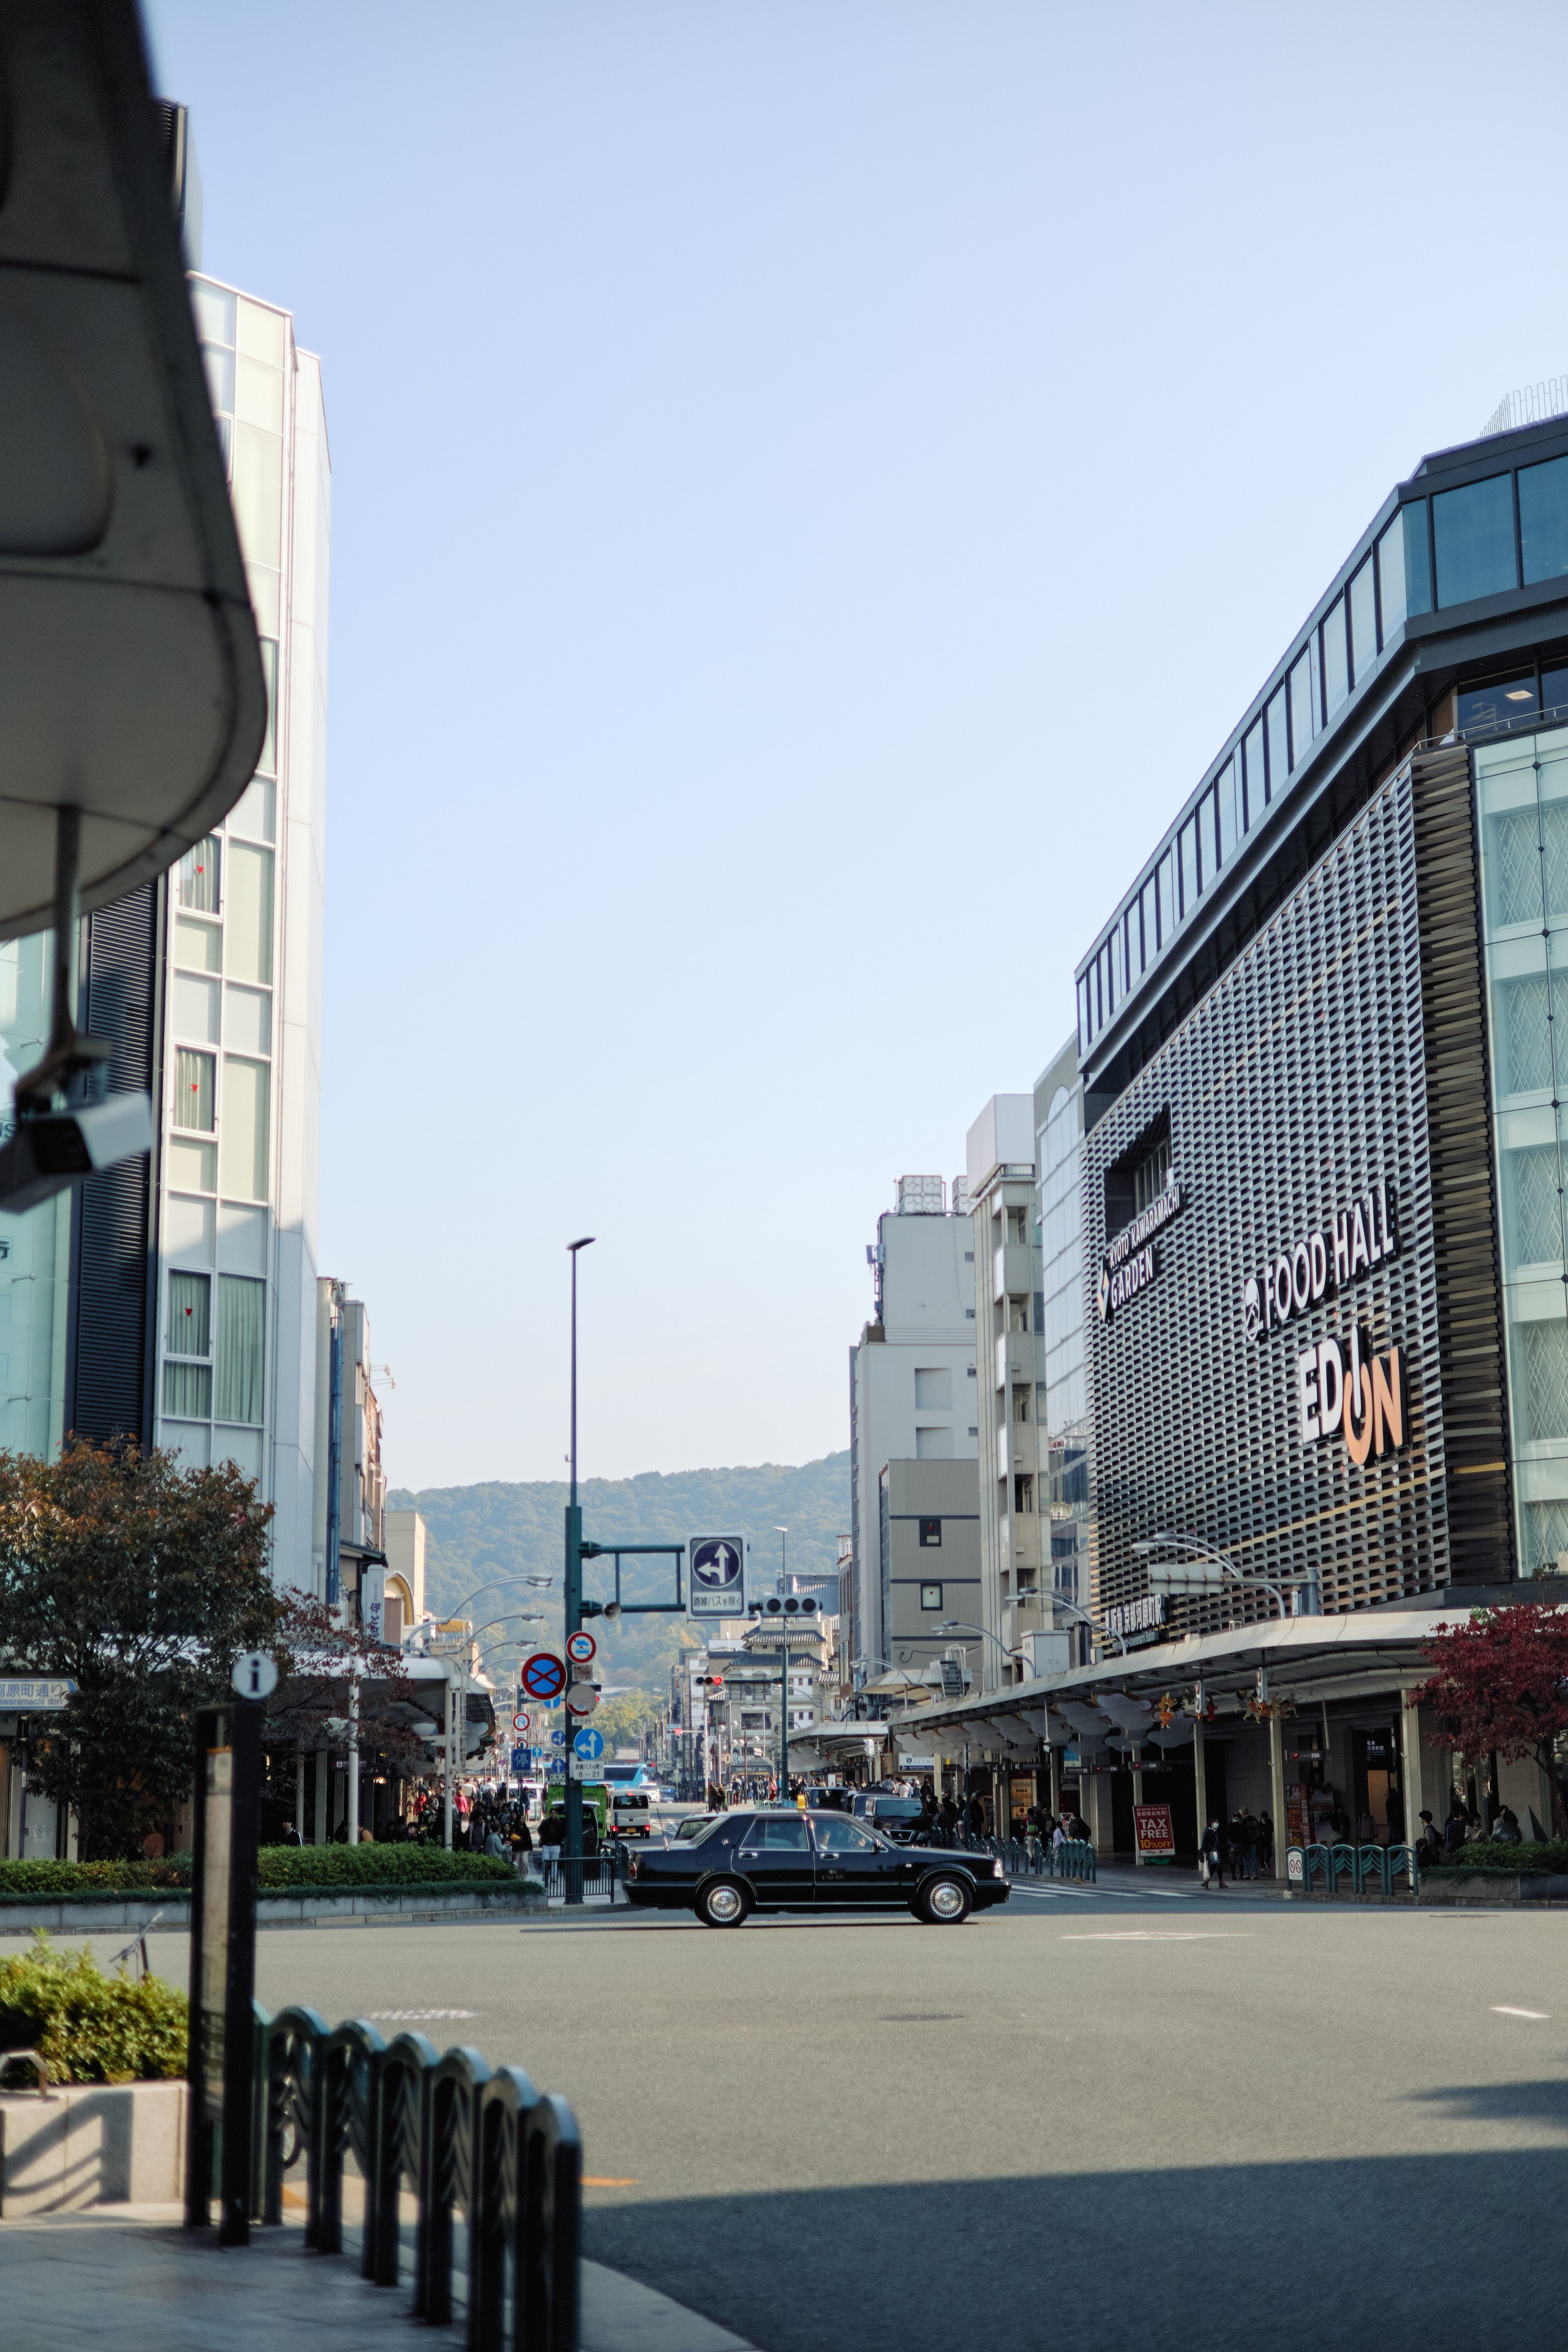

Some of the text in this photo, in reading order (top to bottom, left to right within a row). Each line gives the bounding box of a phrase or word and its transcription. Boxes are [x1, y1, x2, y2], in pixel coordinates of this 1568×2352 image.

[1110, 1184, 1180, 1269] KYOTO KAWARAMACHI
[1265, 1181, 1394, 1330] FOOD HALL
[1110, 1245, 1153, 1310] GARDEN
[693, 1596, 742, 1607] 路線バスを除く
[0, 1697, 45, 1706] awaramachi
[514, 1752, 529, 1768] 停
[1139, 1818, 1167, 1830] TAX
[1140, 1829, 1169, 1839] FREE
[1140, 1839, 1171, 1849] 10%OFF
